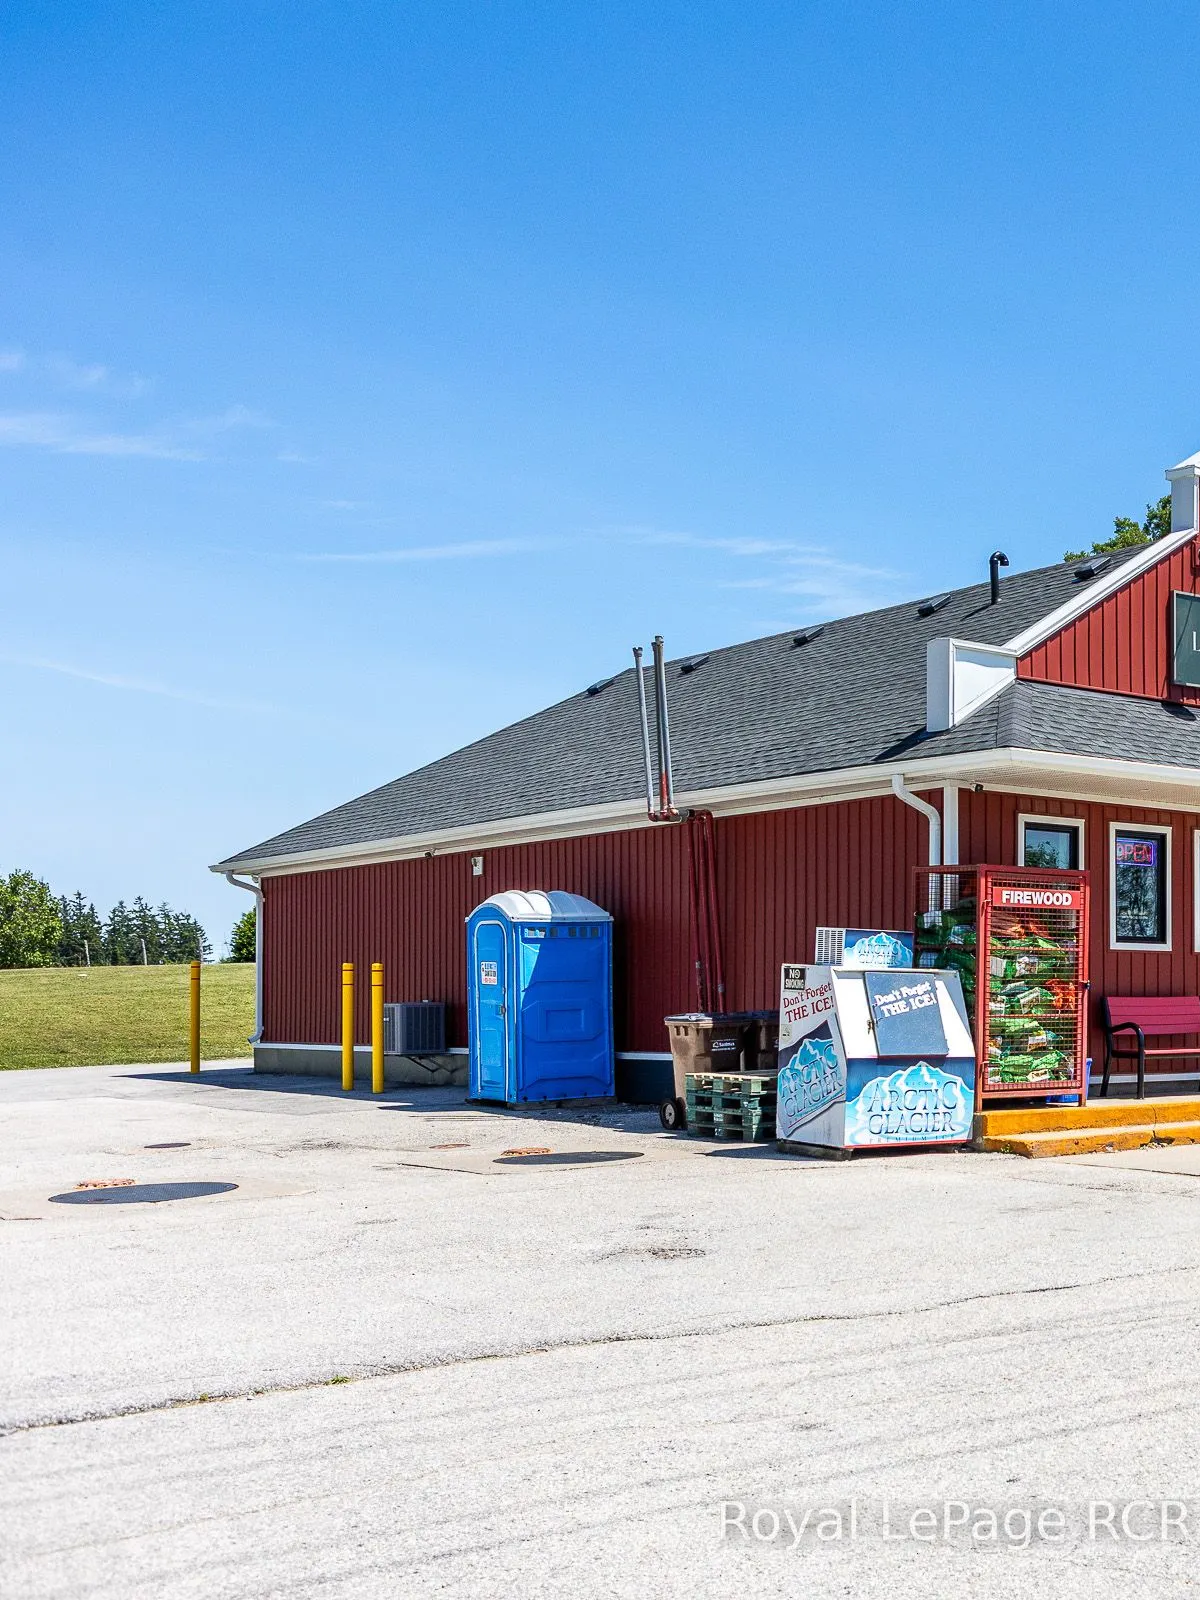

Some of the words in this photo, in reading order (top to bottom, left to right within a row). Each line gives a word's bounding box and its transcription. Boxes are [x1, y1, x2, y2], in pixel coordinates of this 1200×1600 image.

[1116, 843, 1151, 862] OPEN
[1002, 890, 1073, 906] FIREWOOD
[858, 941, 899, 955] ARCTIC
[859, 954, 898, 965] GLACIER
[789, 969, 801, 979] NO
[783, 991, 804, 1008] Don't
[805, 981, 832, 1000] Forget
[874, 990, 901, 1006] Don't
[900, 981, 931, 998] Forget
[881, 1000, 910, 1017] THE
[909, 993, 937, 1010] ICE!
[785, 1004, 810, 1023] THE
[811, 995, 834, 1014] ICE!
[781, 1043, 838, 1098] ARCTIC
[784, 1070, 843, 1117] GLACIER
[867, 1081, 958, 1112] ARCTIC
[868, 1112, 956, 1134] GLACIER
